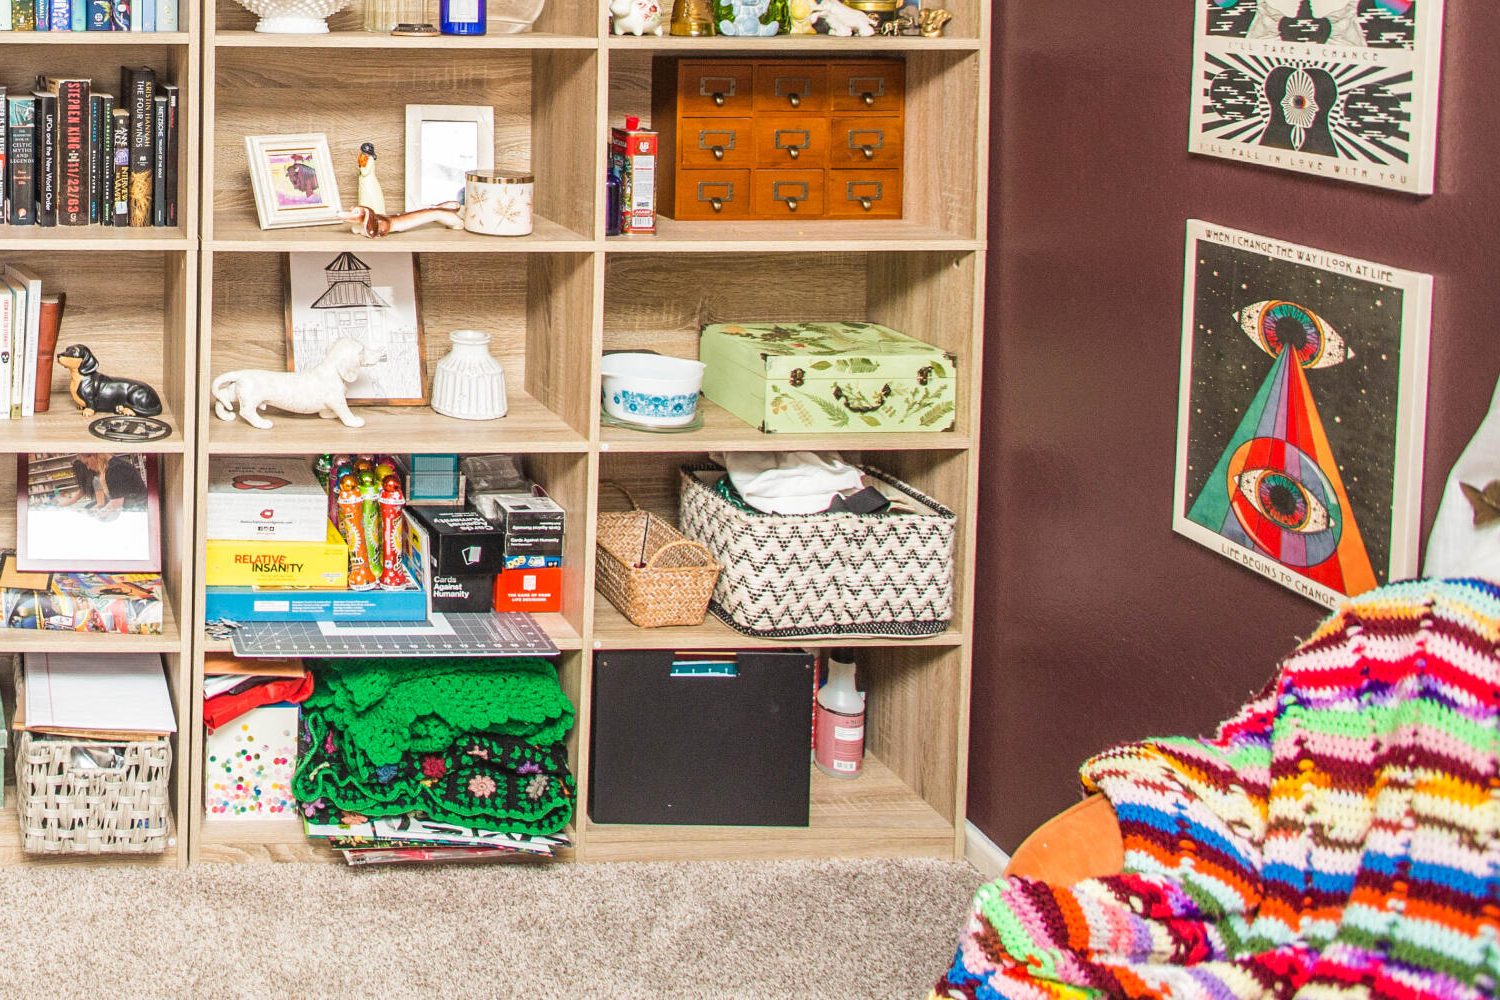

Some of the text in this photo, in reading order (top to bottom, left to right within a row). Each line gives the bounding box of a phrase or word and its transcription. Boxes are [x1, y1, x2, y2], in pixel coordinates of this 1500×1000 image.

[1228, 41, 1252, 51] I'LL
[1263, 44, 1295, 54] TAKE
[1321, 48, 1379, 61] CHANCE
[67, 82, 81, 150] STEPHEN KING
[135, 80, 145, 148] THE FOUR WINDS
[144, 81, 153, 148] KRISTIN HANNAH
[120, 127, 129, 147] ANNE
[1198, 142, 1408, 185] I'LL FALL IN LOVE WITH YOU
[67, 163, 81, 214] 11/22/63
[1205, 229, 1230, 242] WHEN
[1236, 236, 1273, 254] CHANGE
[1275, 244, 1293, 258] THE
[1296, 249, 1318, 263] WAY
[1326, 256, 1353, 272] LOOK
[1354, 265, 1369, 276] AT
[1371, 268, 1393, 283] LIFE
[433, 517, 485, 525] Humanity
[234, 554, 288, 565] RELATIVE
[1221, 543, 1337, 607] LIFE BEGINS TO CHANGE
[433, 576, 456, 585] Cards
[433, 583, 463, 593] Against
[433, 592, 470, 601] Humanity
